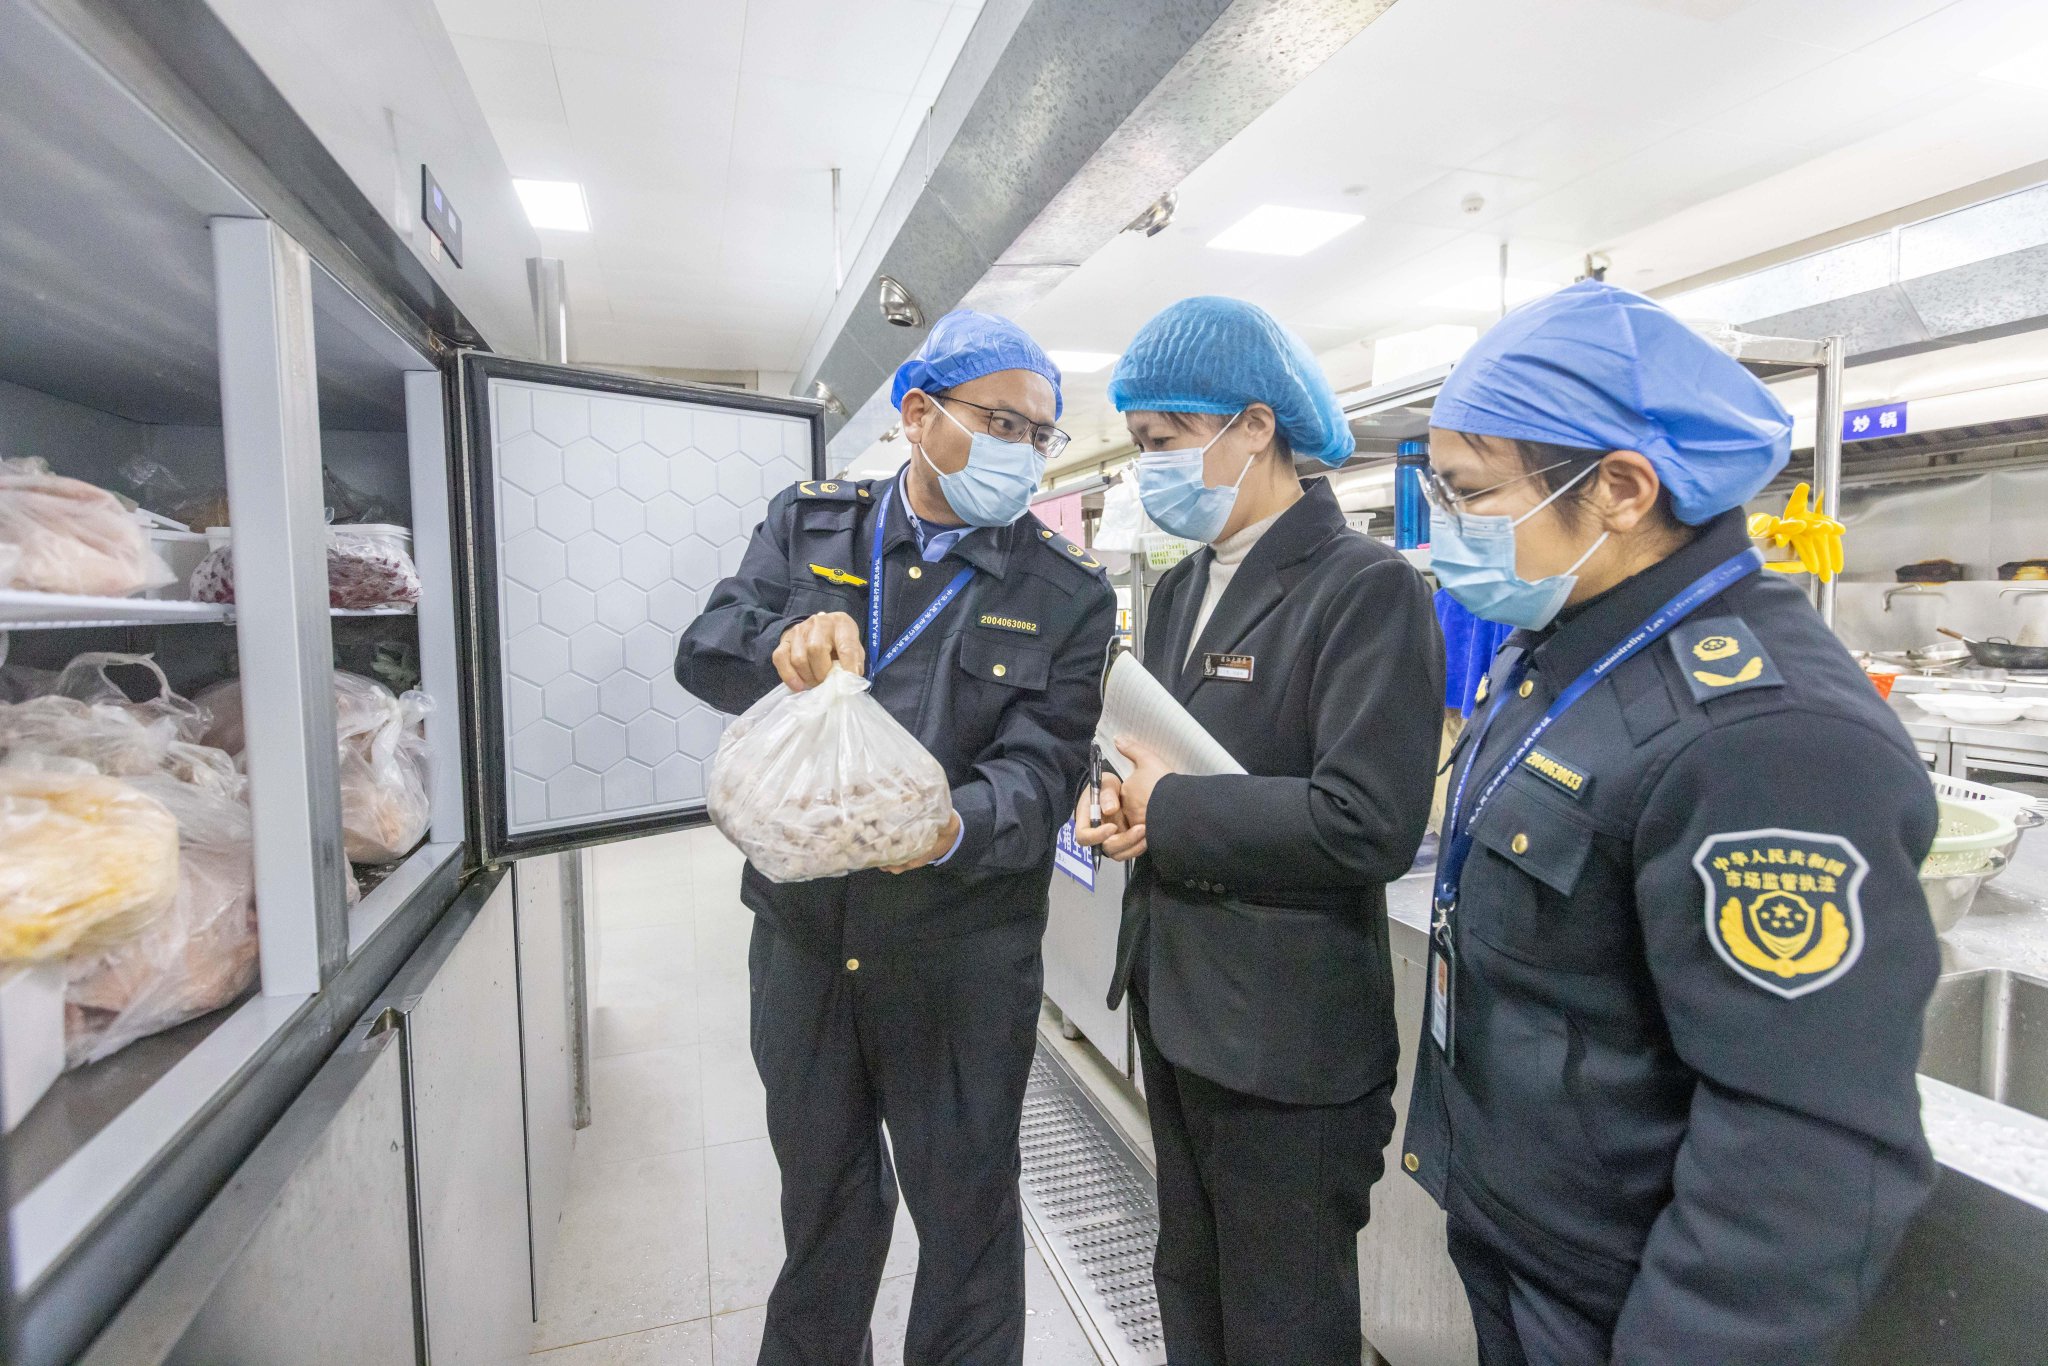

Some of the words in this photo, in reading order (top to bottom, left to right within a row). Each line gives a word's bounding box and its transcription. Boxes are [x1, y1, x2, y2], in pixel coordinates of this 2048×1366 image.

[1852, 411, 1898, 433] 炒锅
[980, 615, 1037, 632] 20040630062
[1593, 632, 1646, 676] Administrative
[1645, 617, 1666, 633] Law
[1712, 848, 1847, 877] 中华人民共和国
[1726, 871, 1837, 893] 市场监管执法
